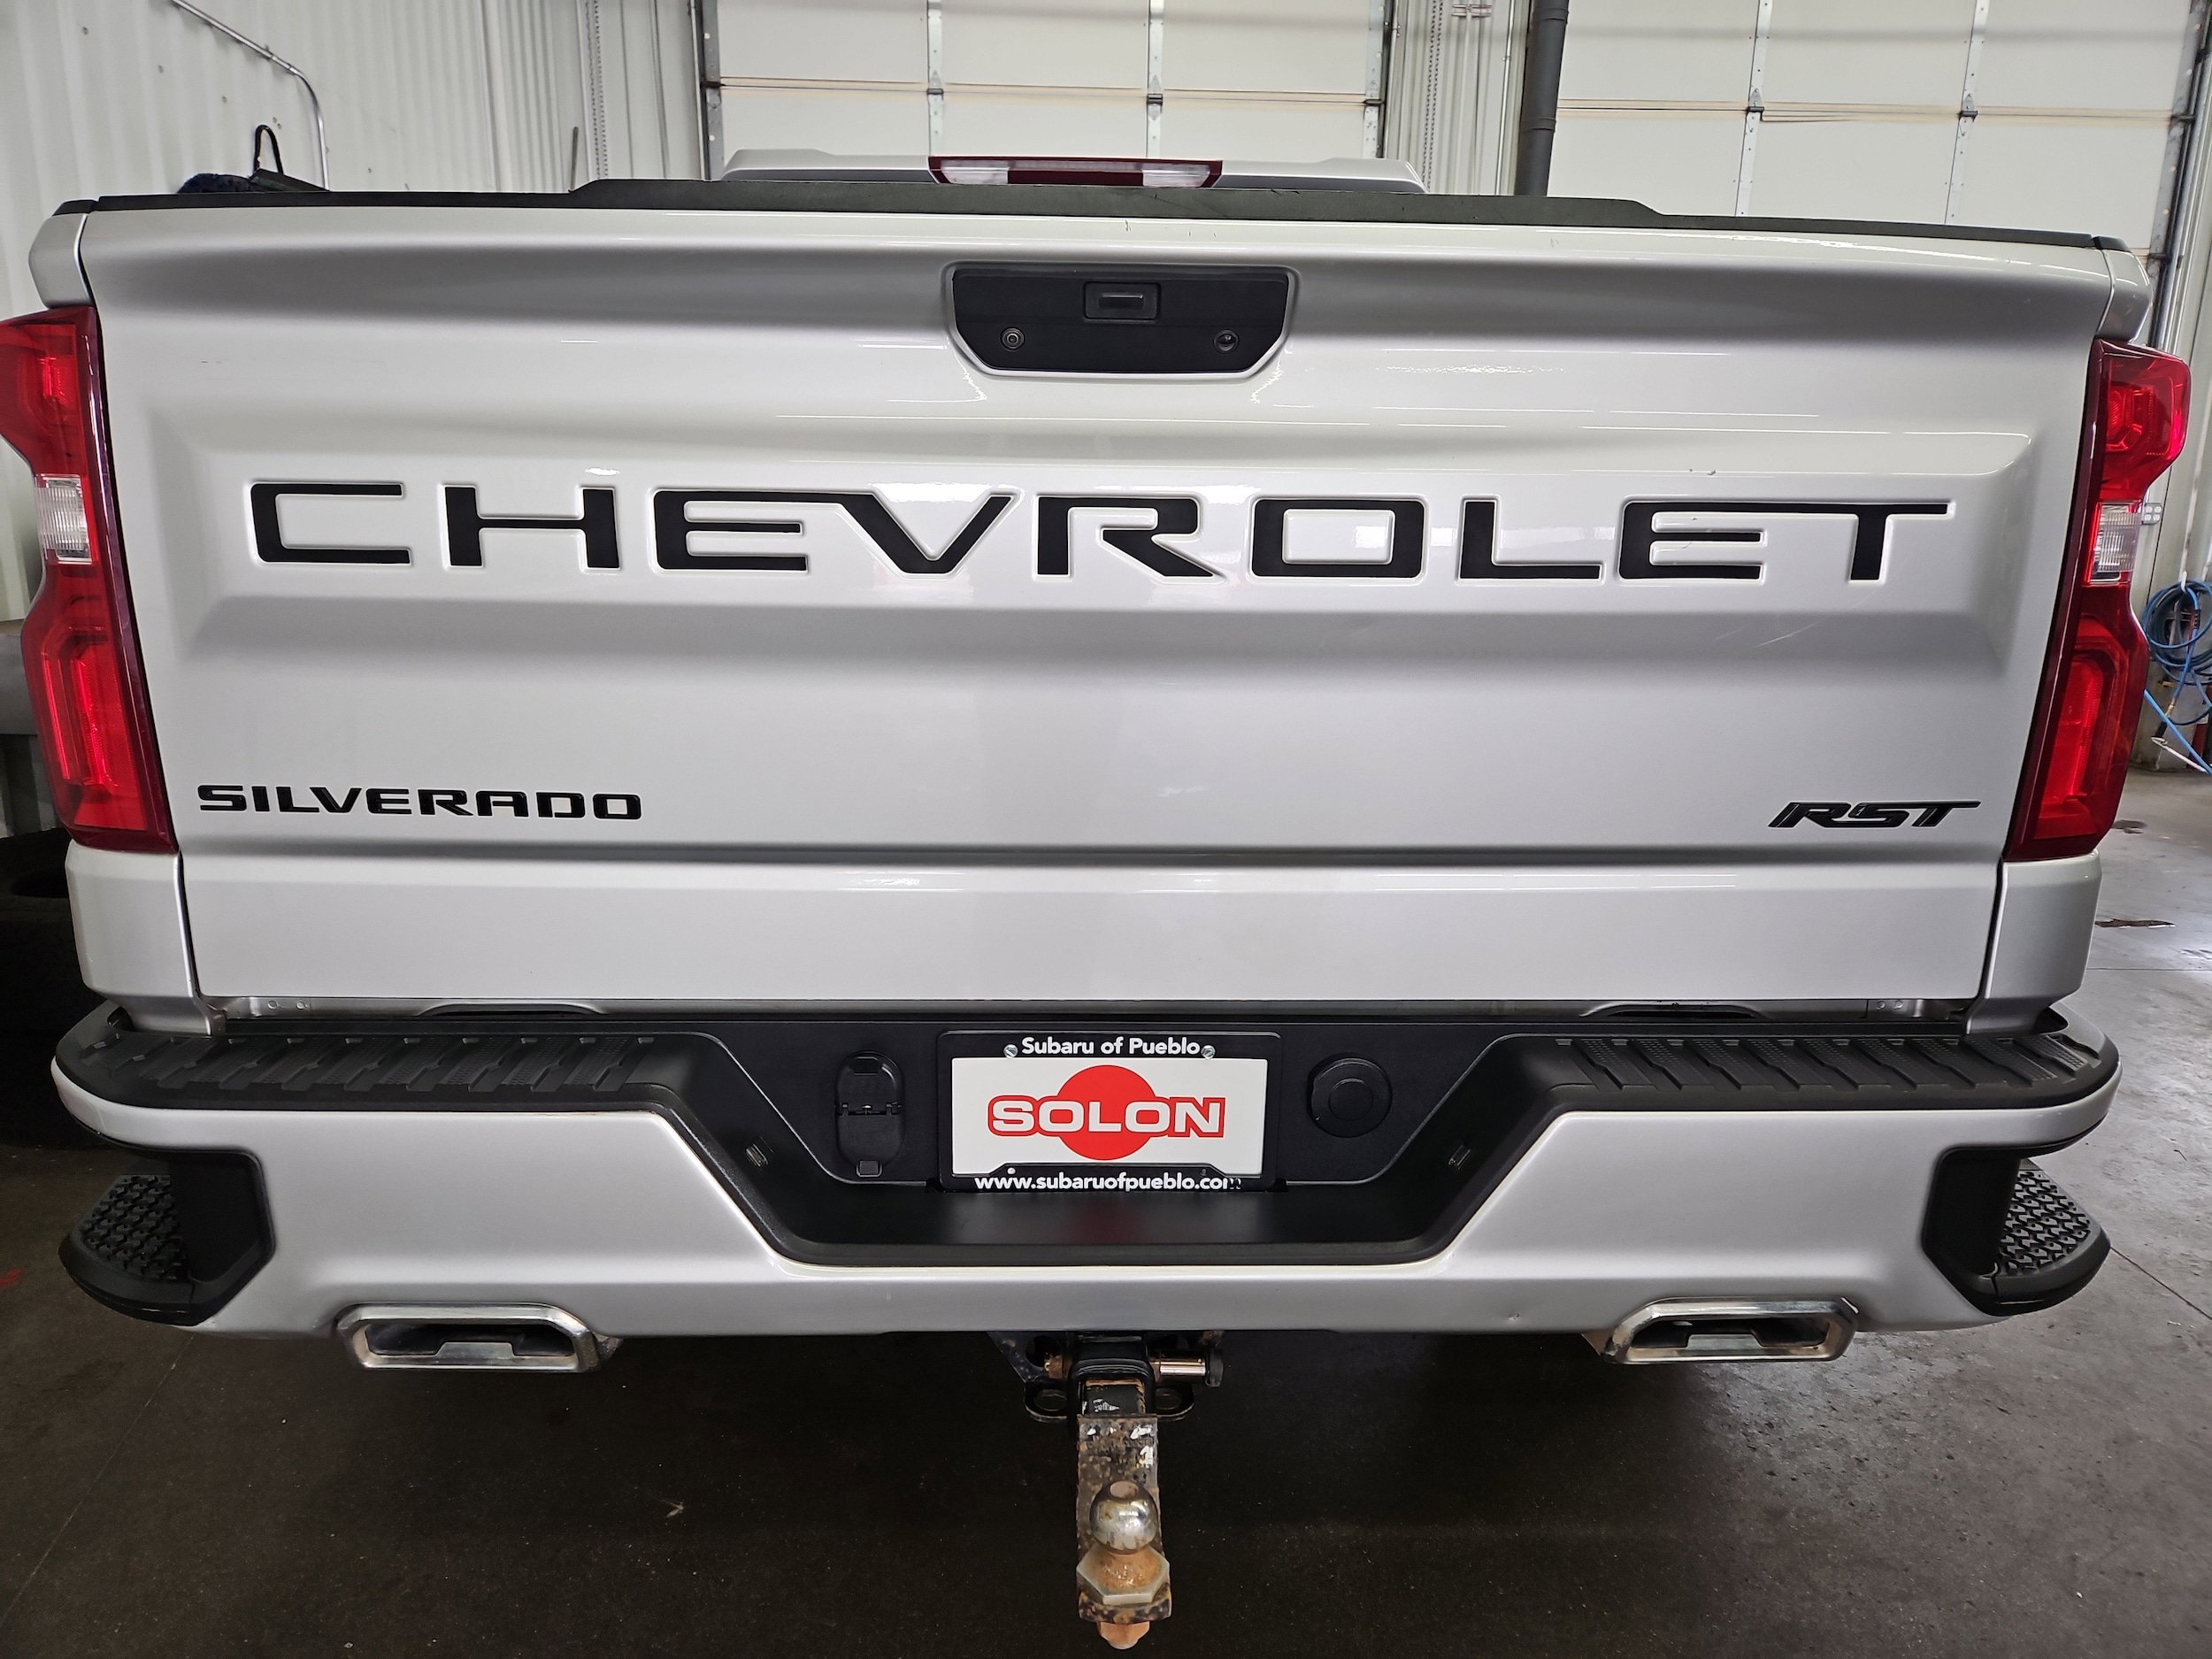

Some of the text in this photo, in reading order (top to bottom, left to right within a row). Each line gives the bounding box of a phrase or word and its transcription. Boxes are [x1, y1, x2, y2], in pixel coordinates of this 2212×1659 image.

[250, 480, 1950, 580] CHEVROLET
[197, 784, 641, 820] SILVERADO
[1767, 800, 1982, 828] RST
[1021, 1036, 1201, 1056] Subaru of Pueblo
[987, 1095, 1226, 1139] SOLON
